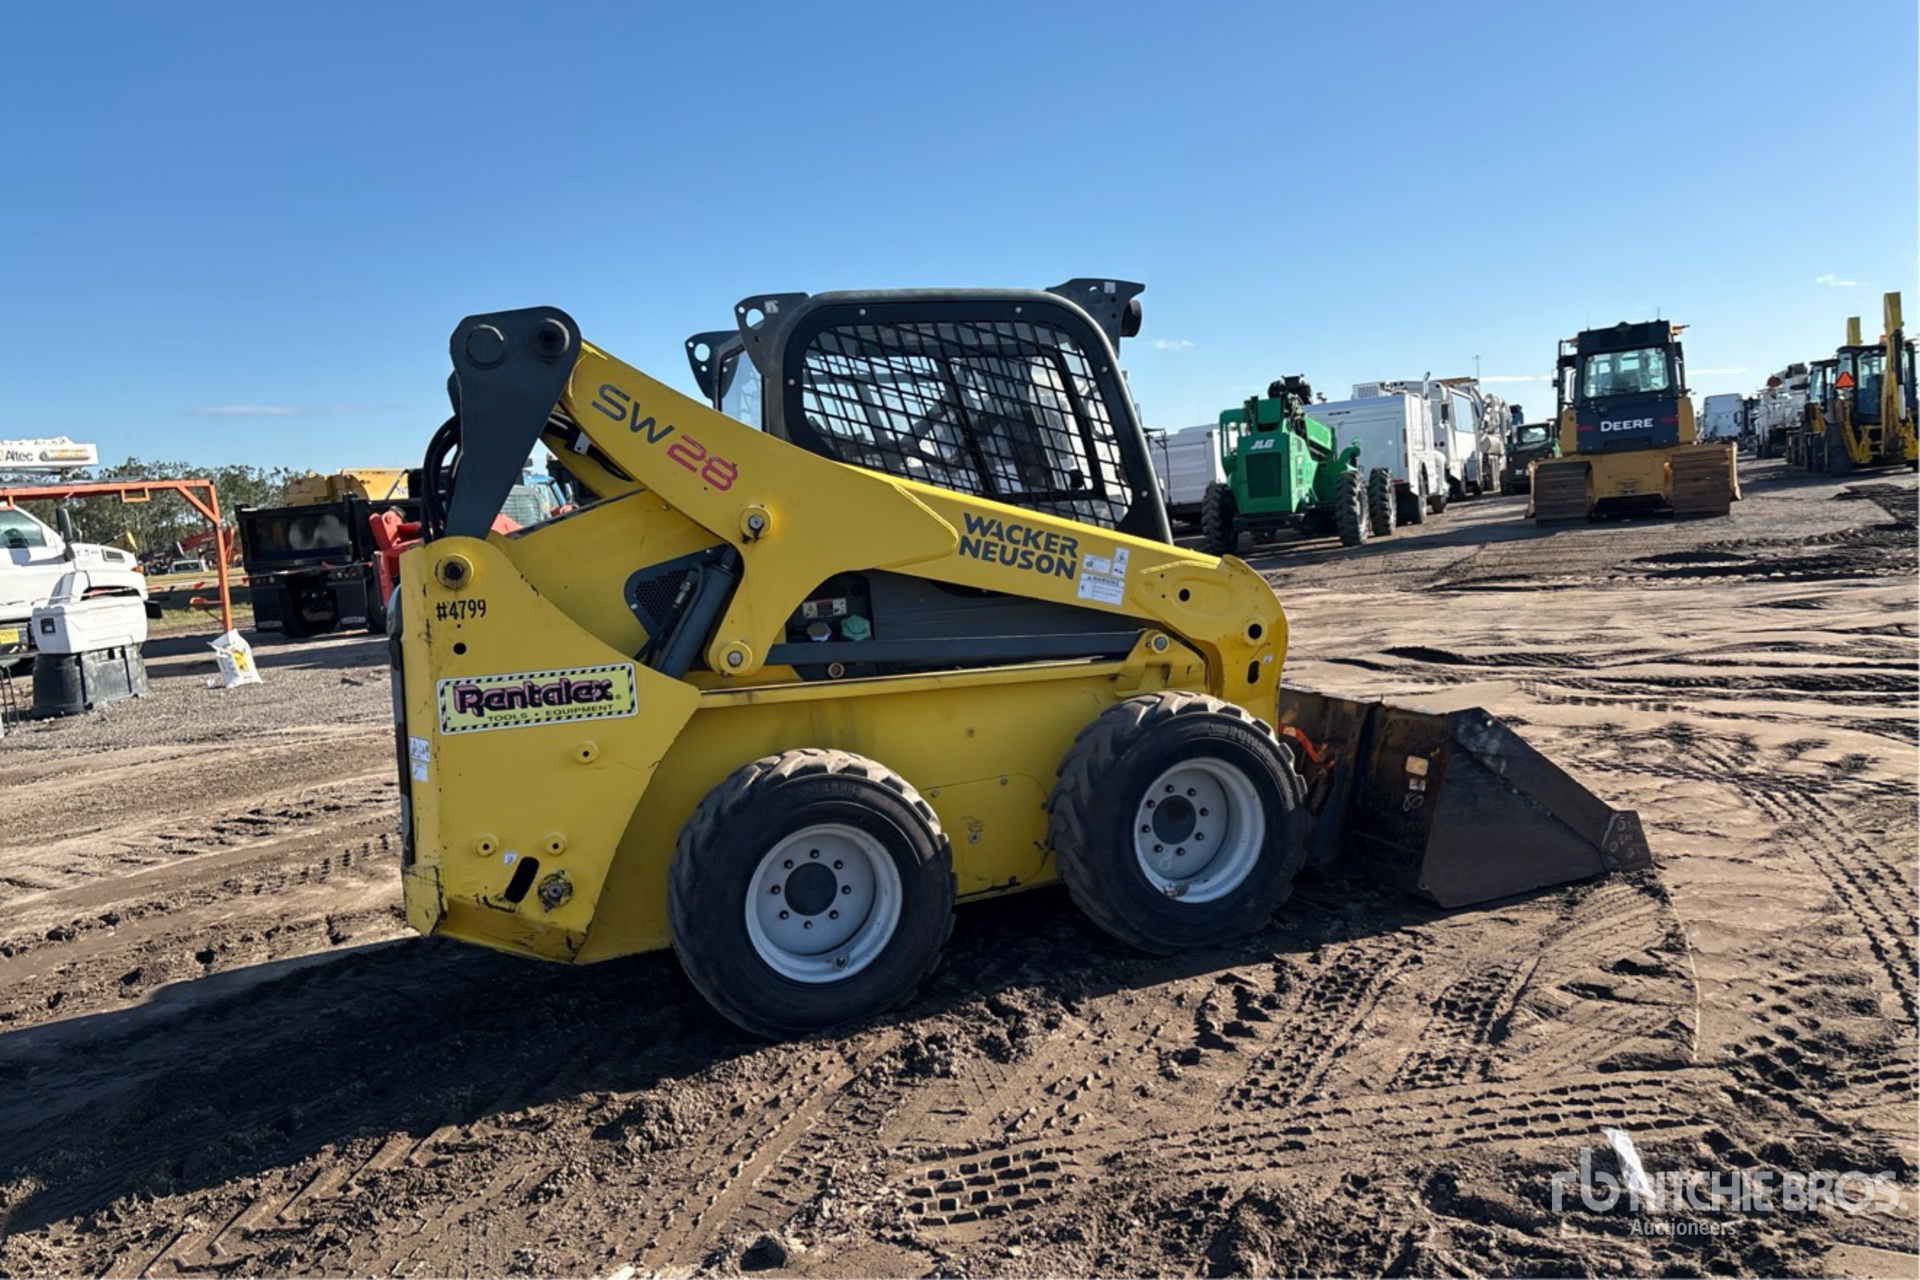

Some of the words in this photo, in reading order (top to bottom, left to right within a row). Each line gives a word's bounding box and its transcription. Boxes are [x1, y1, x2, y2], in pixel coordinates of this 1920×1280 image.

[1601, 418, 1654, 432] DEERE
[591, 384, 675, 444] SW
[666, 434, 738, 491] 28
[1250, 438, 1275, 450] JLG
[5, 450, 34, 462] Altec
[963, 512, 1079, 558] WACKER
[958, 536, 1077, 580] NEUSON
[436, 599, 486, 621] #4799
[453, 678, 613, 717] Rentalex
[488, 712, 528, 723] TOOLS
[546, 704, 614, 717] EQUIPMENT
